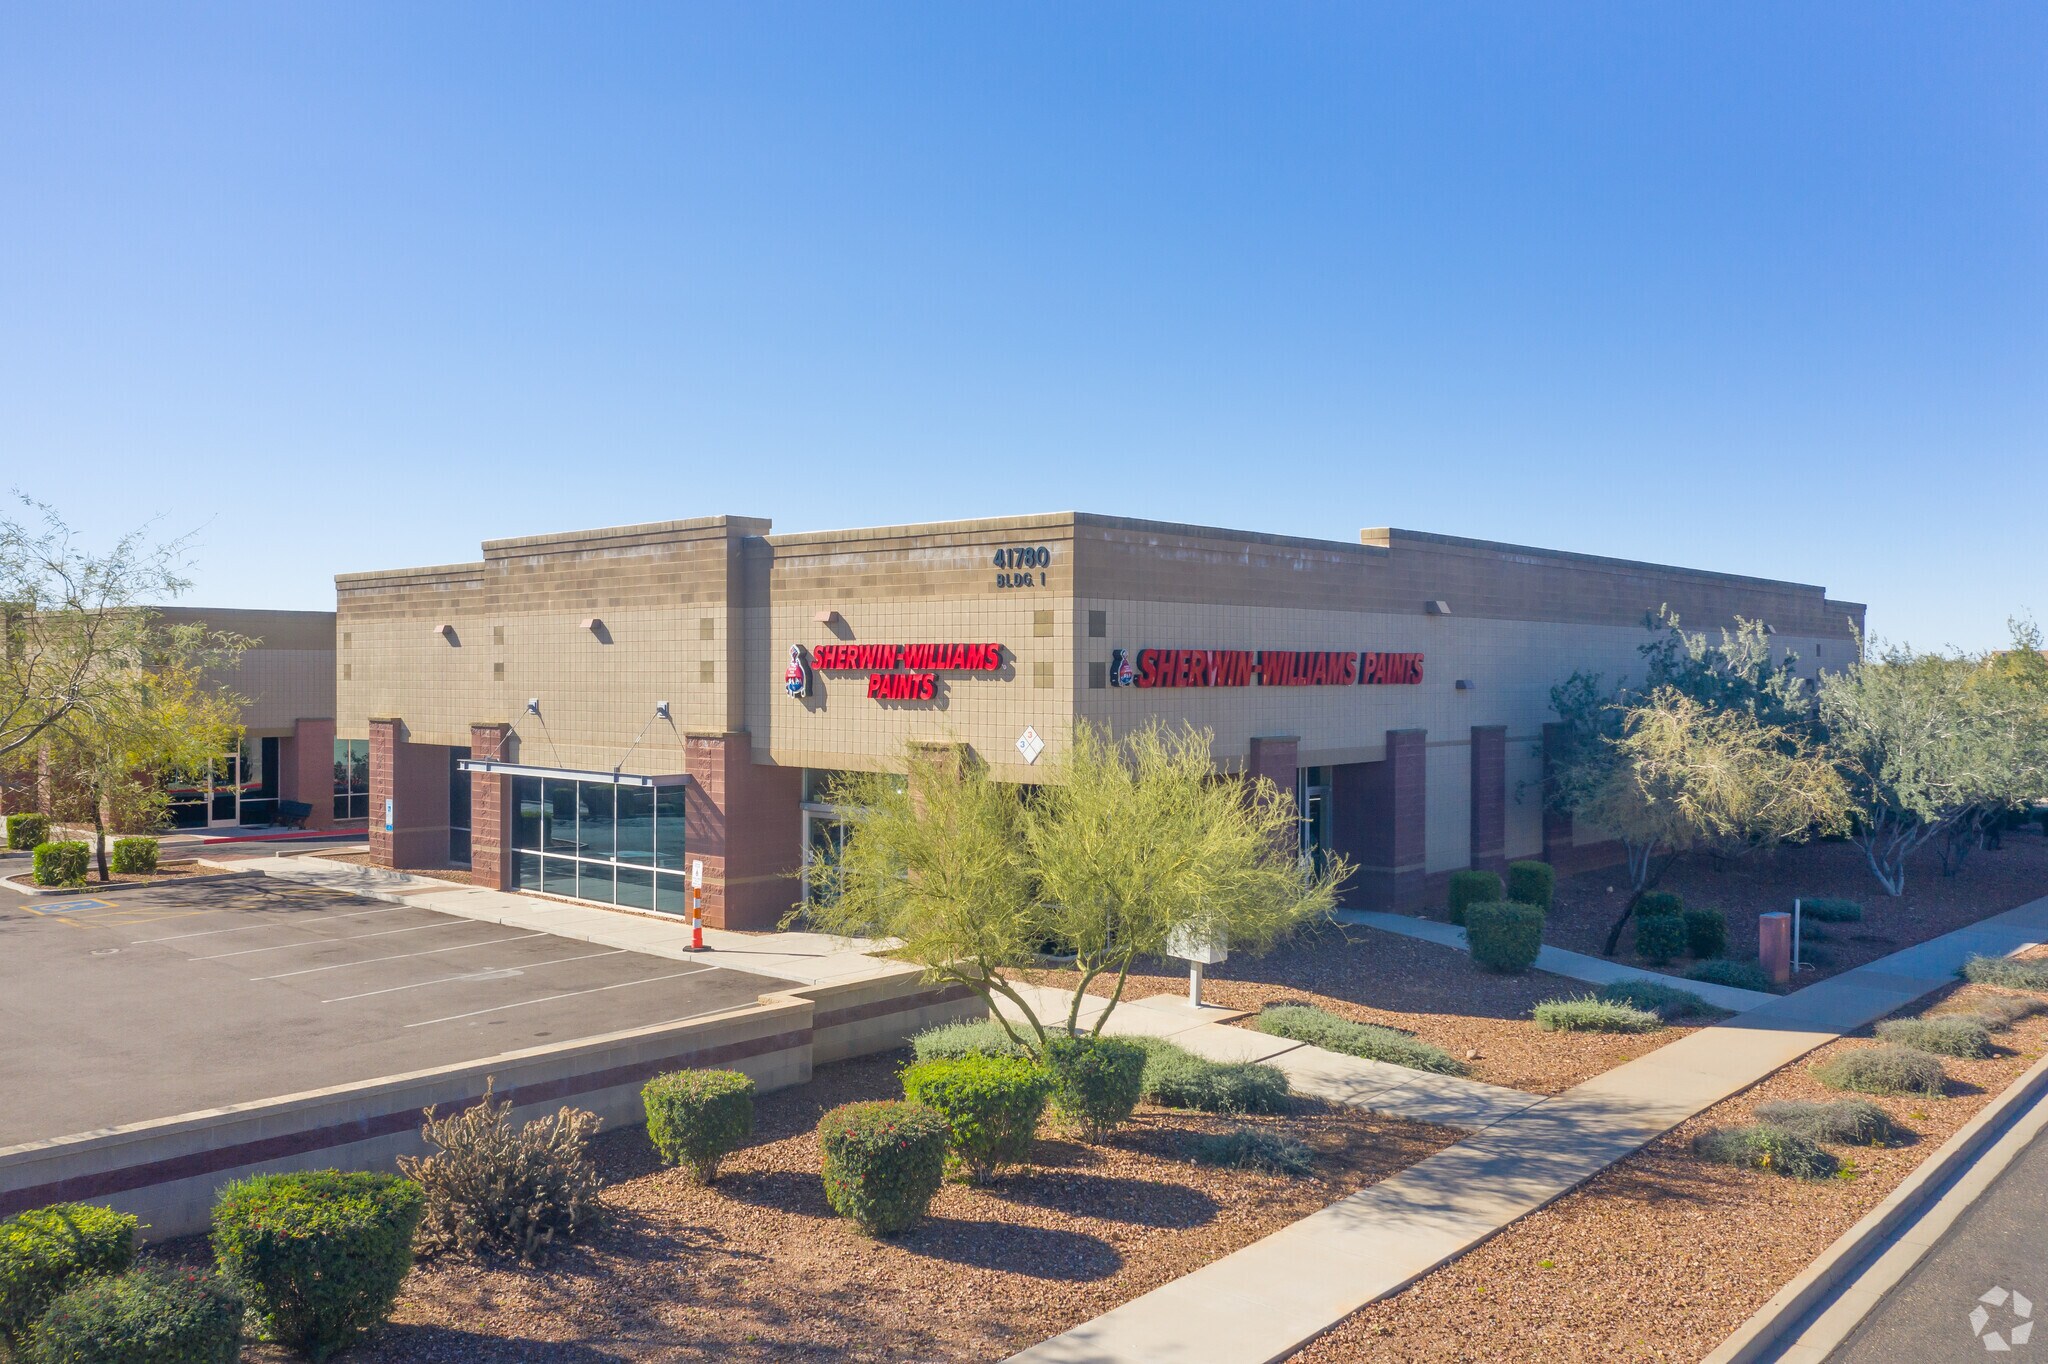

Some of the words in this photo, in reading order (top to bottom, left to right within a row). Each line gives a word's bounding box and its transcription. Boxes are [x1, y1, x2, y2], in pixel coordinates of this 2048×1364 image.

[993, 546, 1050, 570] 41780
[1040, 572, 1046, 587] 1
[812, 643, 1001, 671] SHERWIN-WILLIAMS
[1135, 648, 1357, 688] SHERWIN-WILLIAMS
[1360, 652, 1425, 685] PAINTS
[867, 673, 937, 701] PAINTS
[1020, 740, 1026, 748] 3
[1027, 731, 1033, 739] 3
